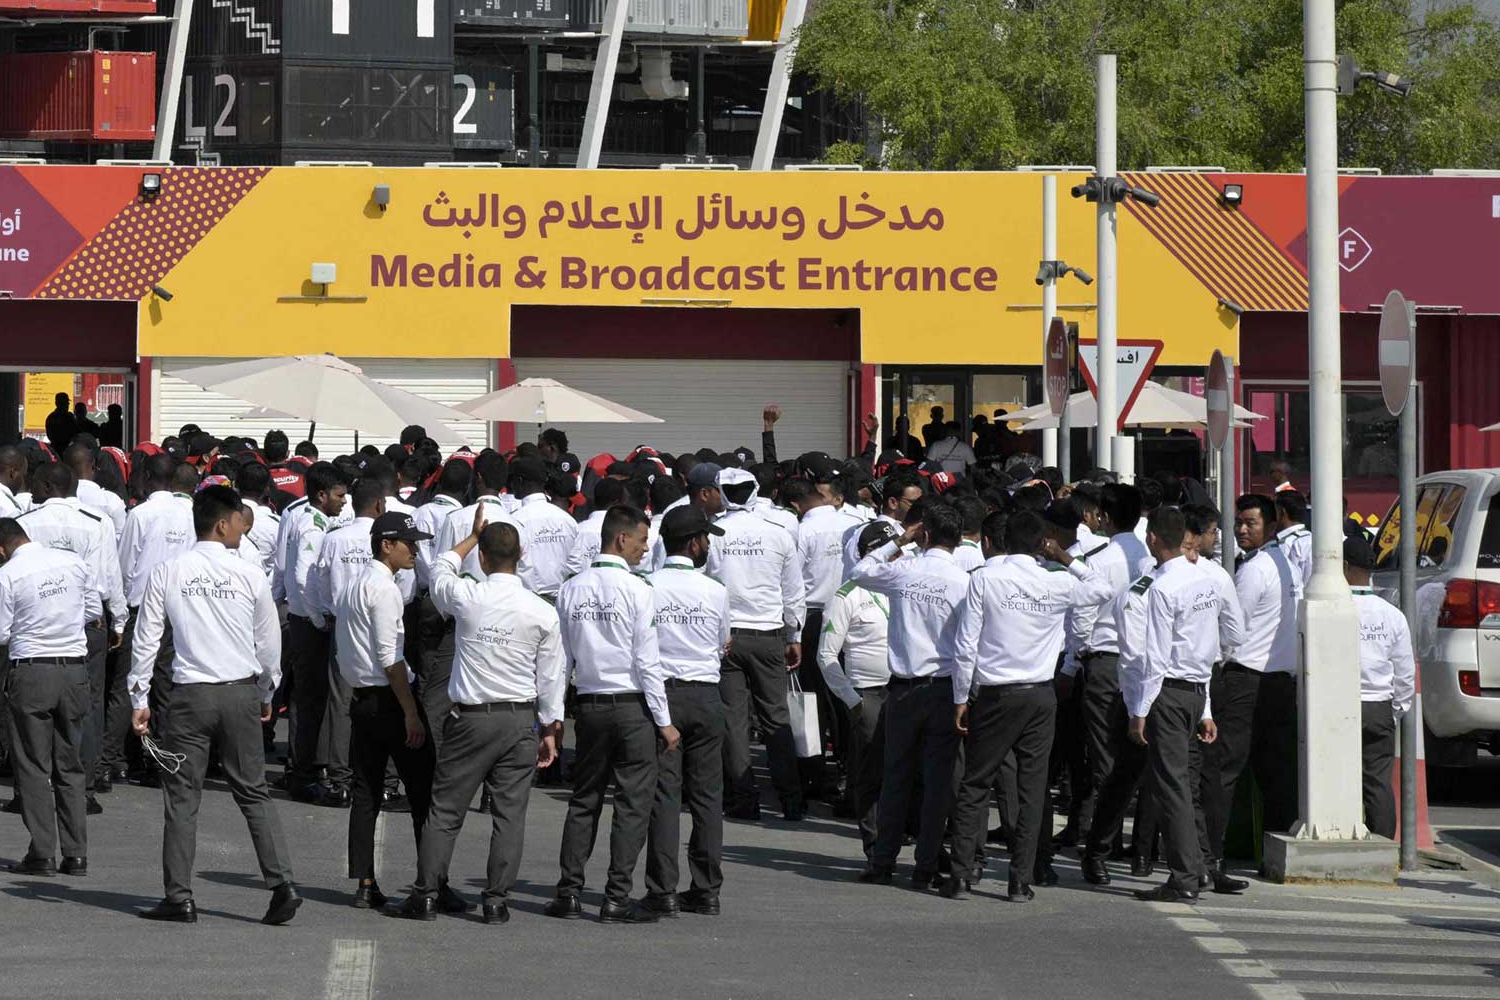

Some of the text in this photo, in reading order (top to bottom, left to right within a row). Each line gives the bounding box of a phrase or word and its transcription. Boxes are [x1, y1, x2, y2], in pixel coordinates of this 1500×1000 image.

[185, 73, 237, 138] L2
[423, 190, 945, 243] مدخل وسائل الإعلام والبث
[1344, 240, 1357, 259] F
[370, 253, 998, 291] Media & Broadcast Entrance
[1049, 376, 1067, 397] STOP
[722, 547, 765, 556] SECURITY
[340, 556, 373, 564] SECUR
[39, 587, 68, 600] SECURITY
[181, 588, 237, 600] SECURITY
[899, 589, 946, 606] SECURITY
[1000, 600, 1053, 612] SECURITY
[571, 611, 620, 622] SECURITY
[654, 613, 707, 625] SECURITY
[1359, 633, 1389, 641] CURITY
